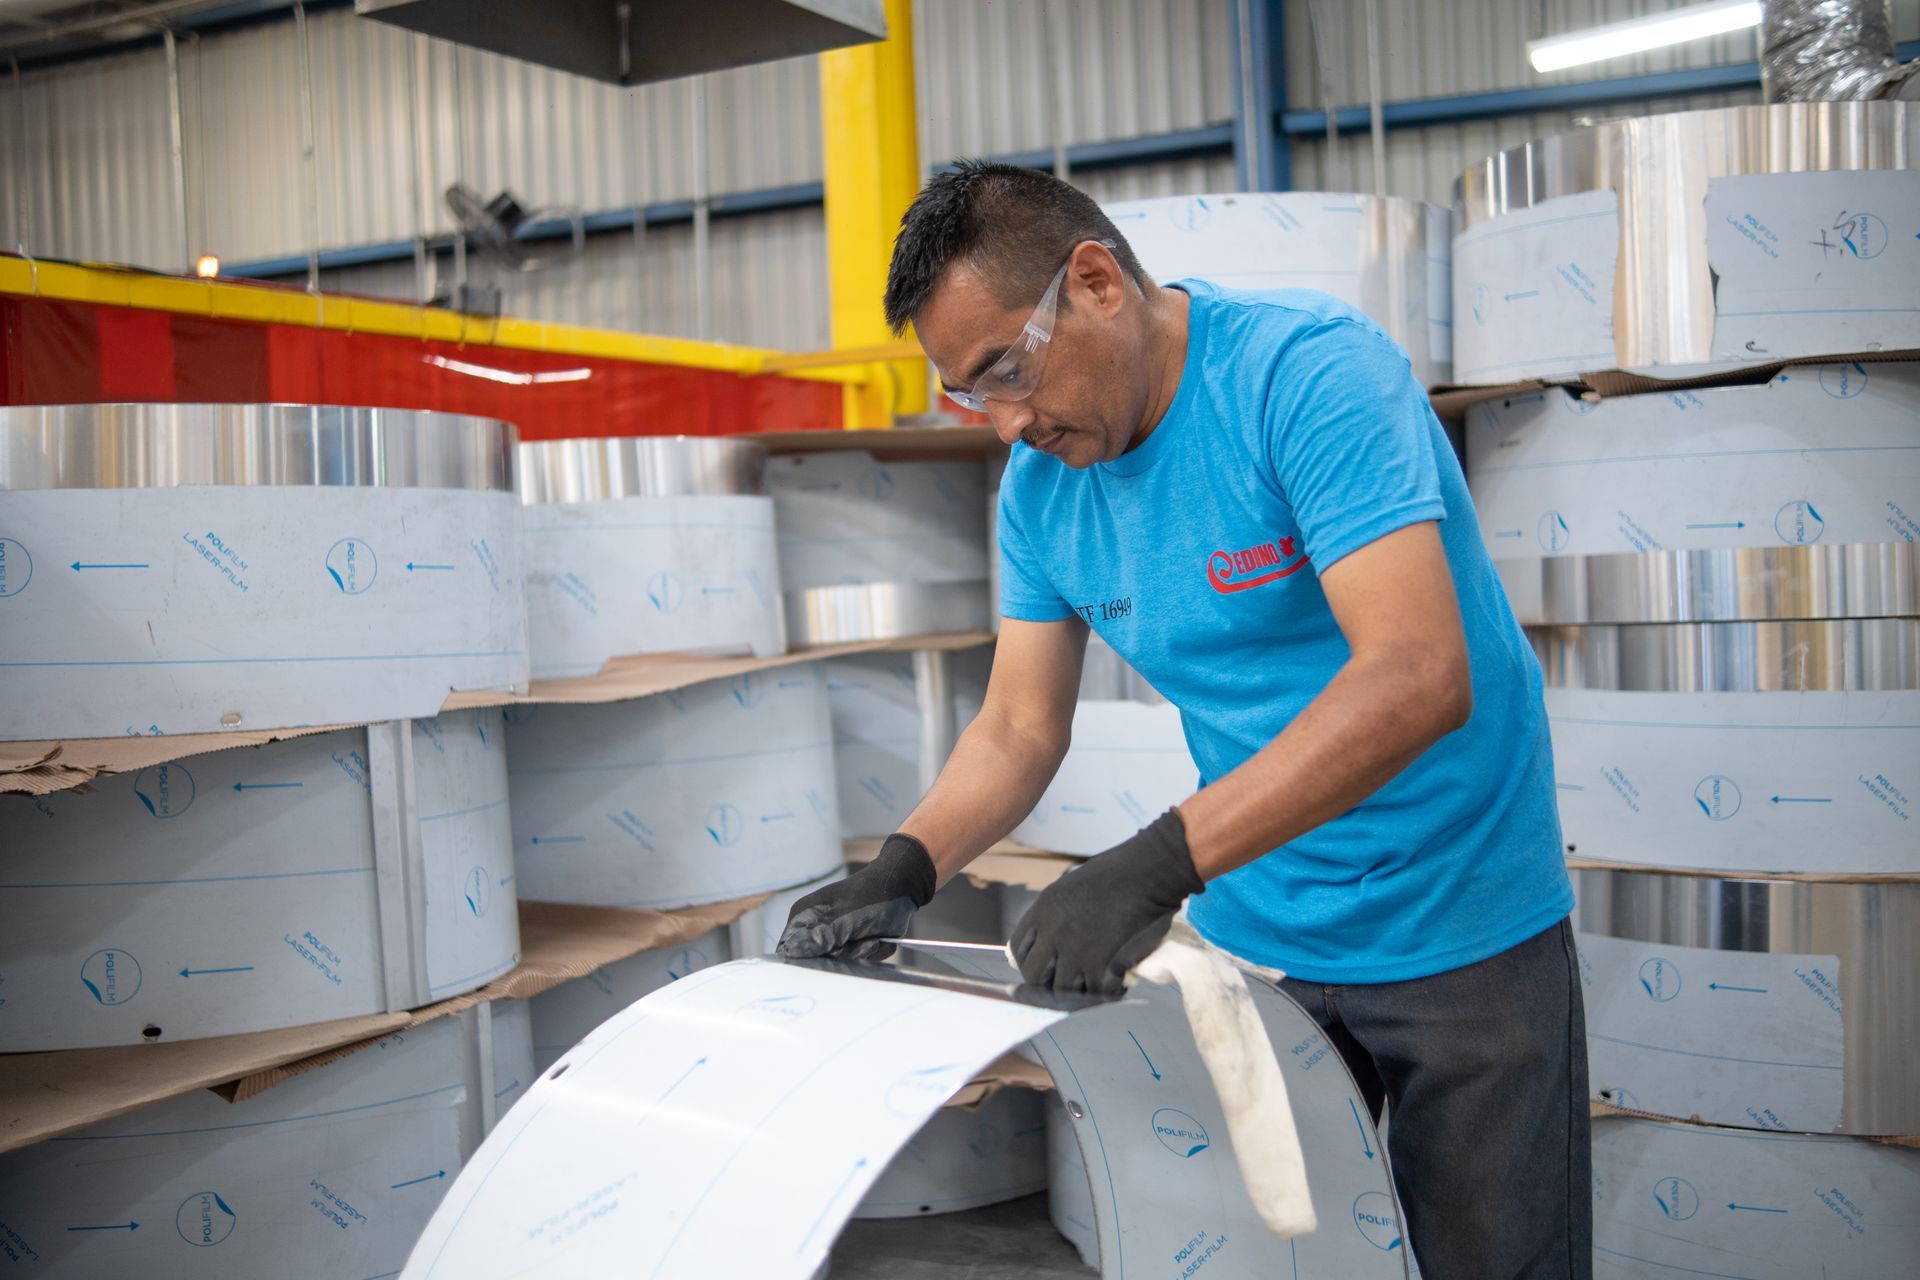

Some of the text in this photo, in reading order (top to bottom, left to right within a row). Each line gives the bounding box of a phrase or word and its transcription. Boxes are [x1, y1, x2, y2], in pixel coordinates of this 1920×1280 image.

[183, 532, 249, 592] LASER-FILM
[206, 532, 249, 572] POLIFILM
[347, 542, 356, 591] POLIFILM
[159, 765, 169, 814] POLIFILM
[1858, 774, 1909, 821] LASER-FILM
[1875, 773, 1908, 805] POLIFILM
[283, 933, 342, 986] LASER-FILM
[304, 931, 341, 966] POLIFILM
[106, 952, 115, 1002] POLIFILM
[1157, 1126, 1205, 1141] POLIFILM
[202, 1195, 212, 1243] POLIFILM
[310, 1179, 368, 1225] LASER-FILM
[311, 1198, 348, 1229] POLIFILM
[1174, 1230, 1208, 1264] POLIFILM
[1176, 1235, 1228, 1280] ASER-FILM
